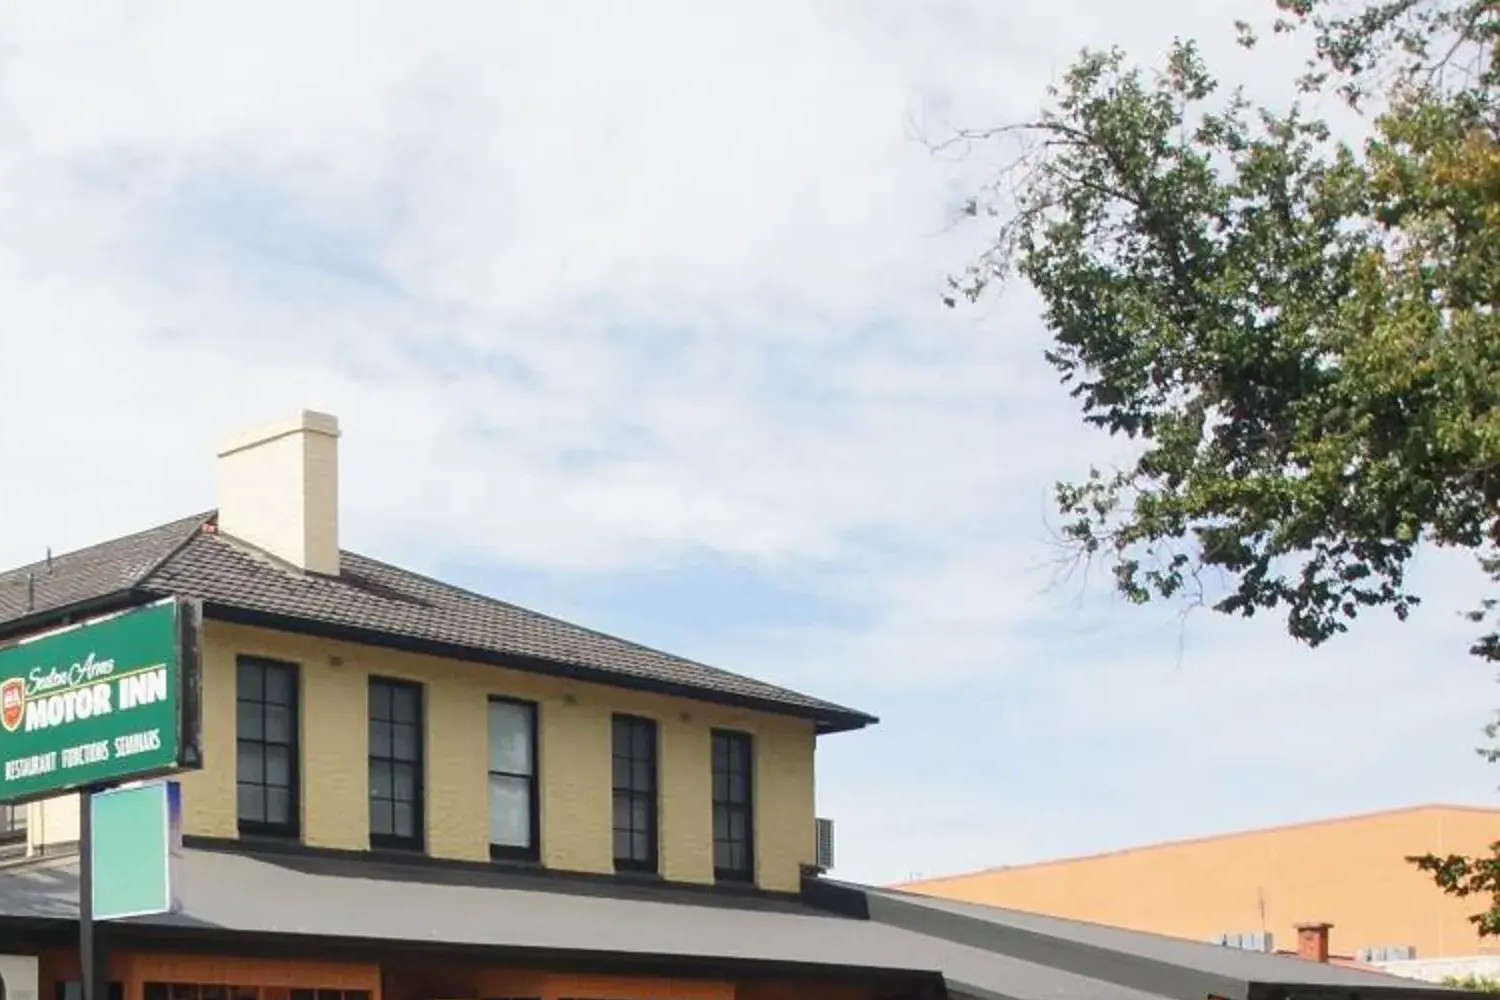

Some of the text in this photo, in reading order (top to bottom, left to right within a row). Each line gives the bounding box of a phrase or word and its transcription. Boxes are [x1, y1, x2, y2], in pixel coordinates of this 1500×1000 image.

[25, 684, 112, 732] MOTOR
[119, 669, 167, 710] INN
[5, 728, 161, 780] RESTAURANT FUNCTIONS SEMINARS
